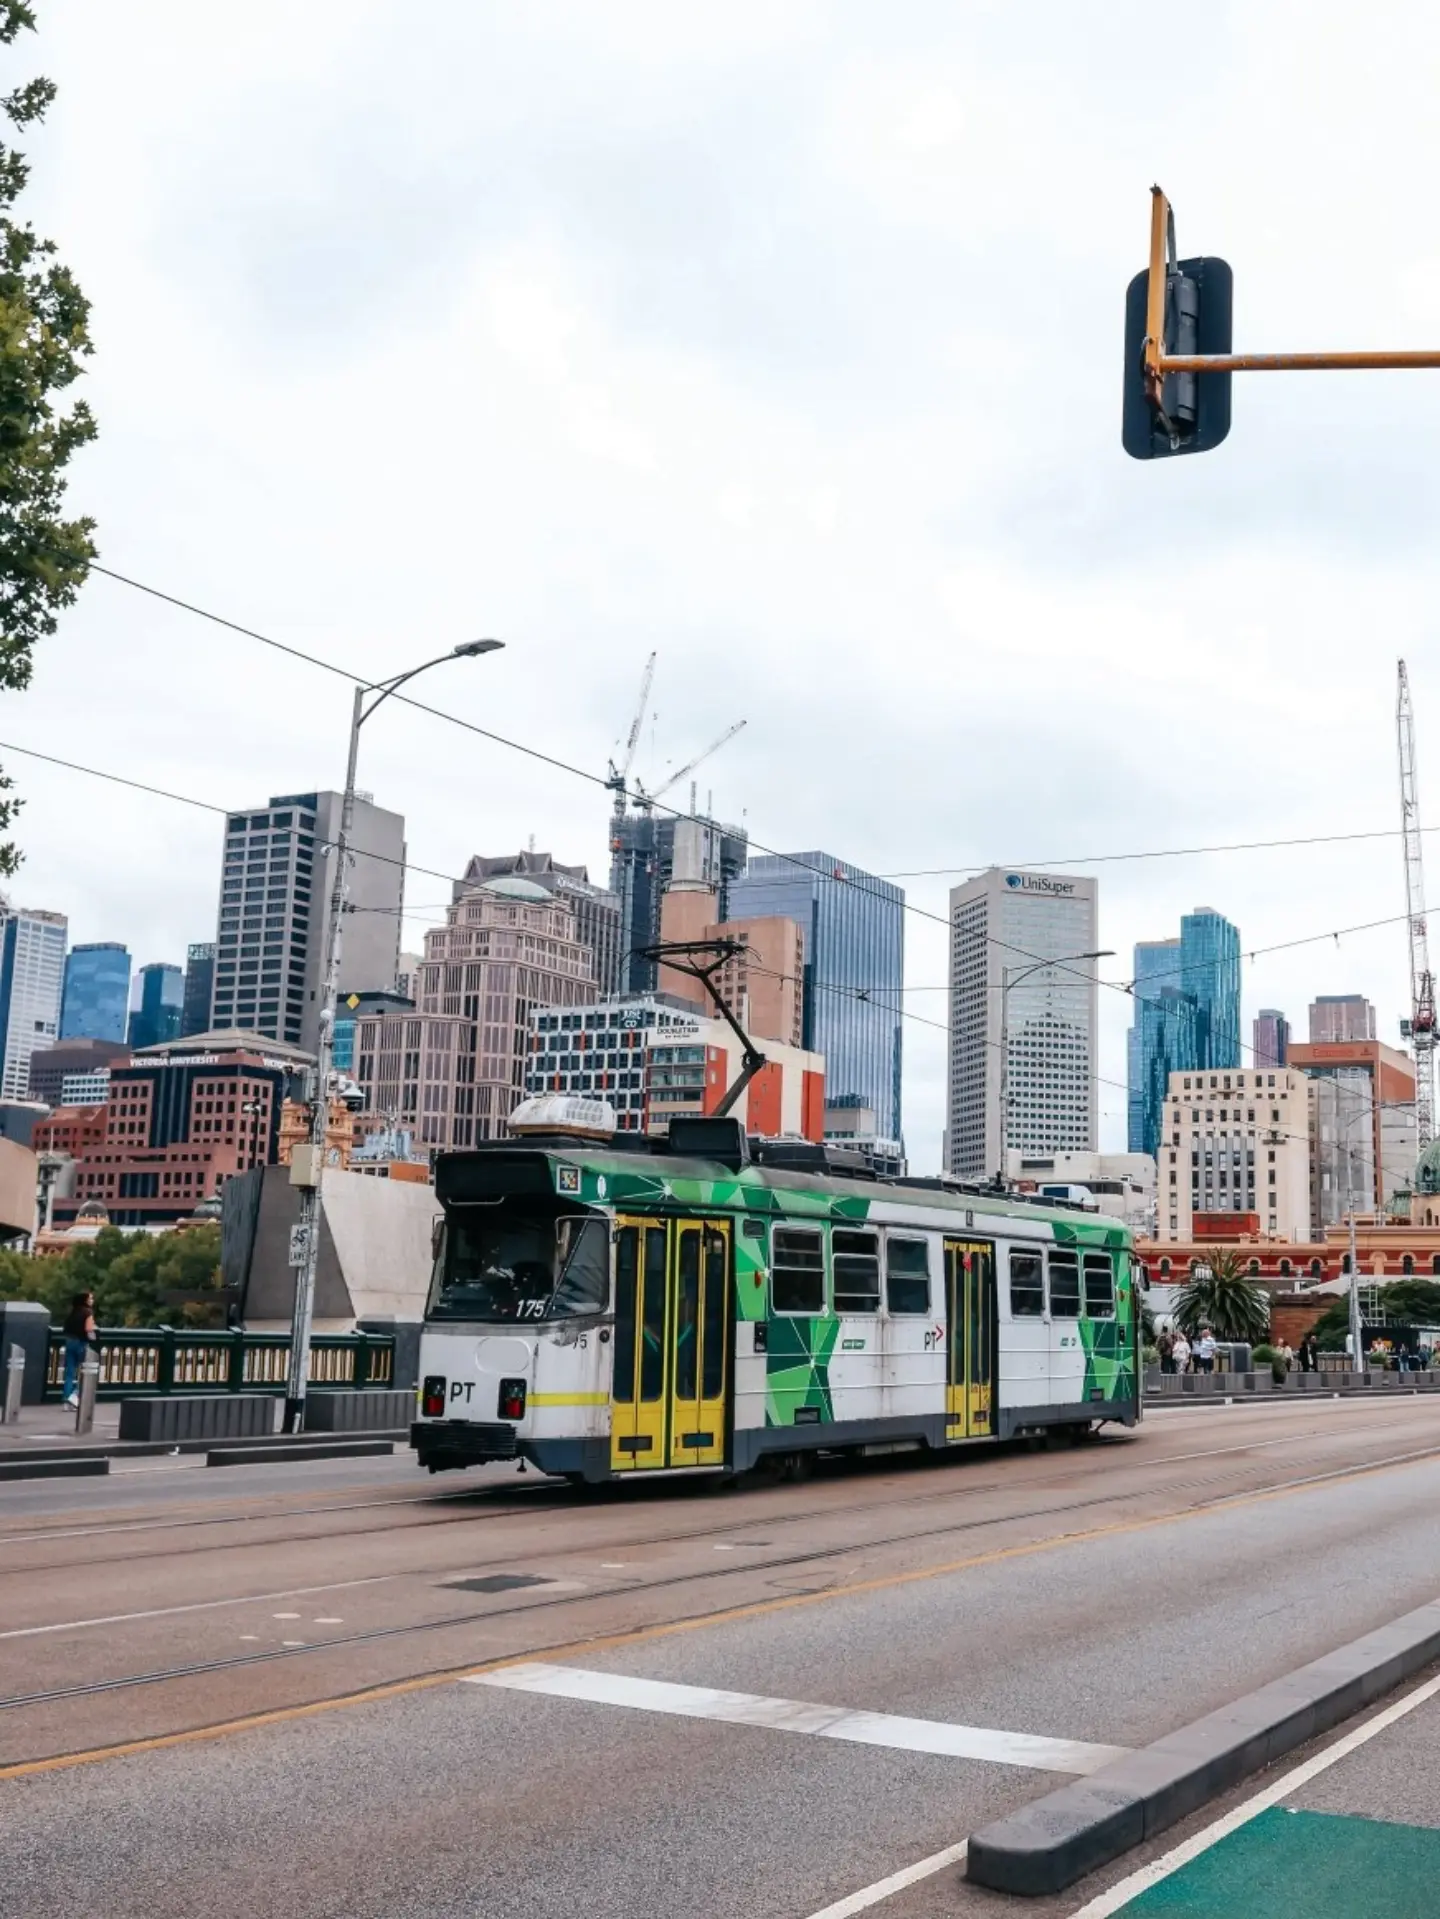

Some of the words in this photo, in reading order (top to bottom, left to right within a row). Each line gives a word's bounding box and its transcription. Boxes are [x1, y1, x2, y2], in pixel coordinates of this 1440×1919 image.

[1022, 876, 1075, 895] UniSuper
[516, 1299, 546, 1318] 175
[450, 1381, 476, 1404] PT
